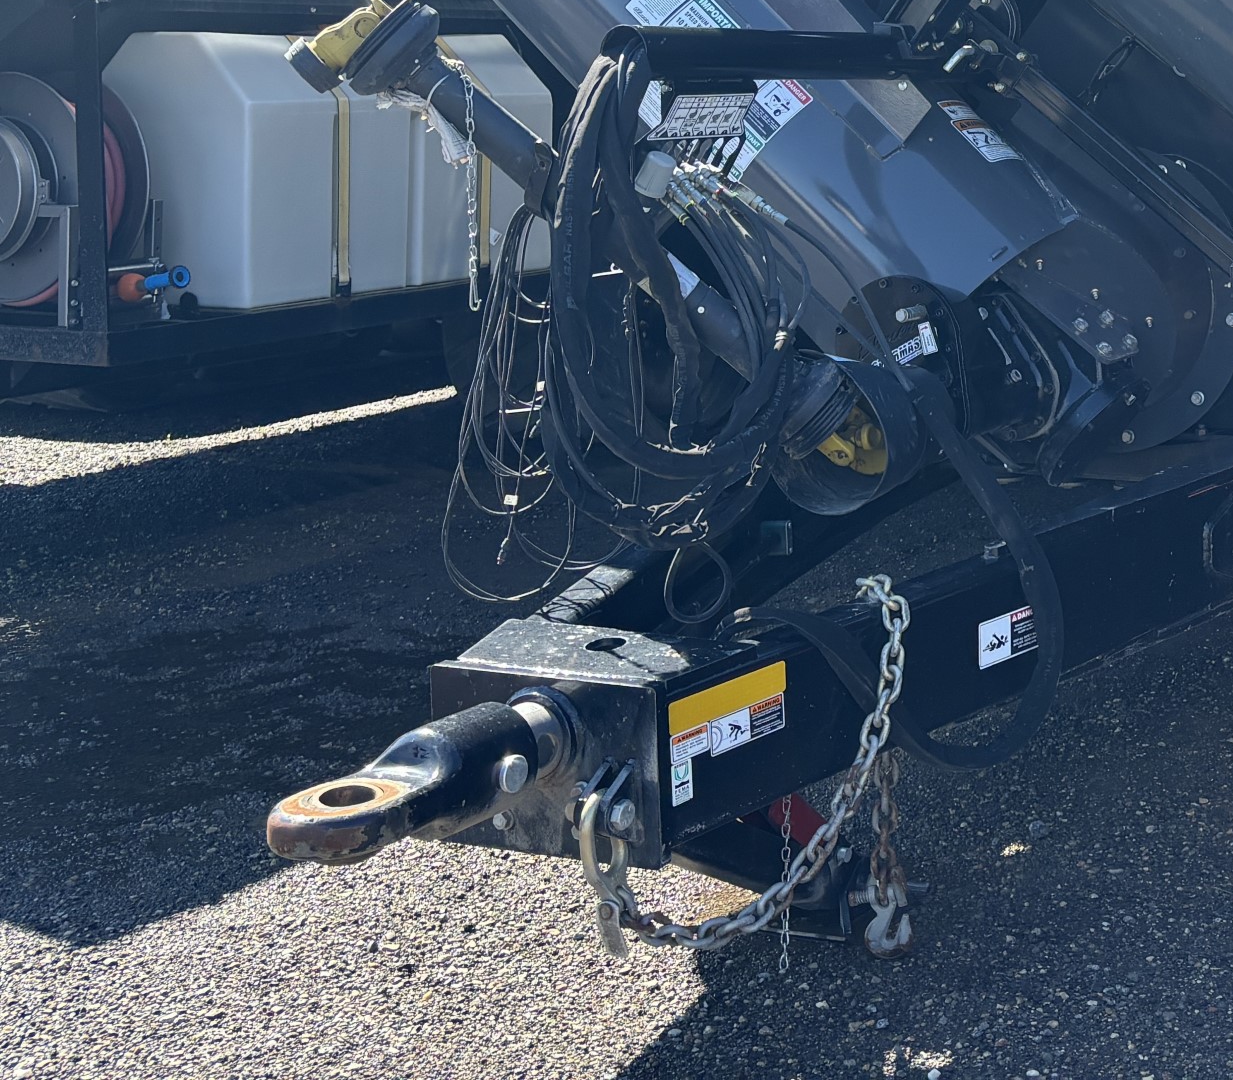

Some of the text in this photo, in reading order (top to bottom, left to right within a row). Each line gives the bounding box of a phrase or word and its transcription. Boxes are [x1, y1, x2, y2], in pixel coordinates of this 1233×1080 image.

[689, 6, 710, 26] MAXIMUM
[786, 80, 806, 102] DANGER
[757, 698, 780, 711] WARNING
[682, 728, 702, 740] WARNING
